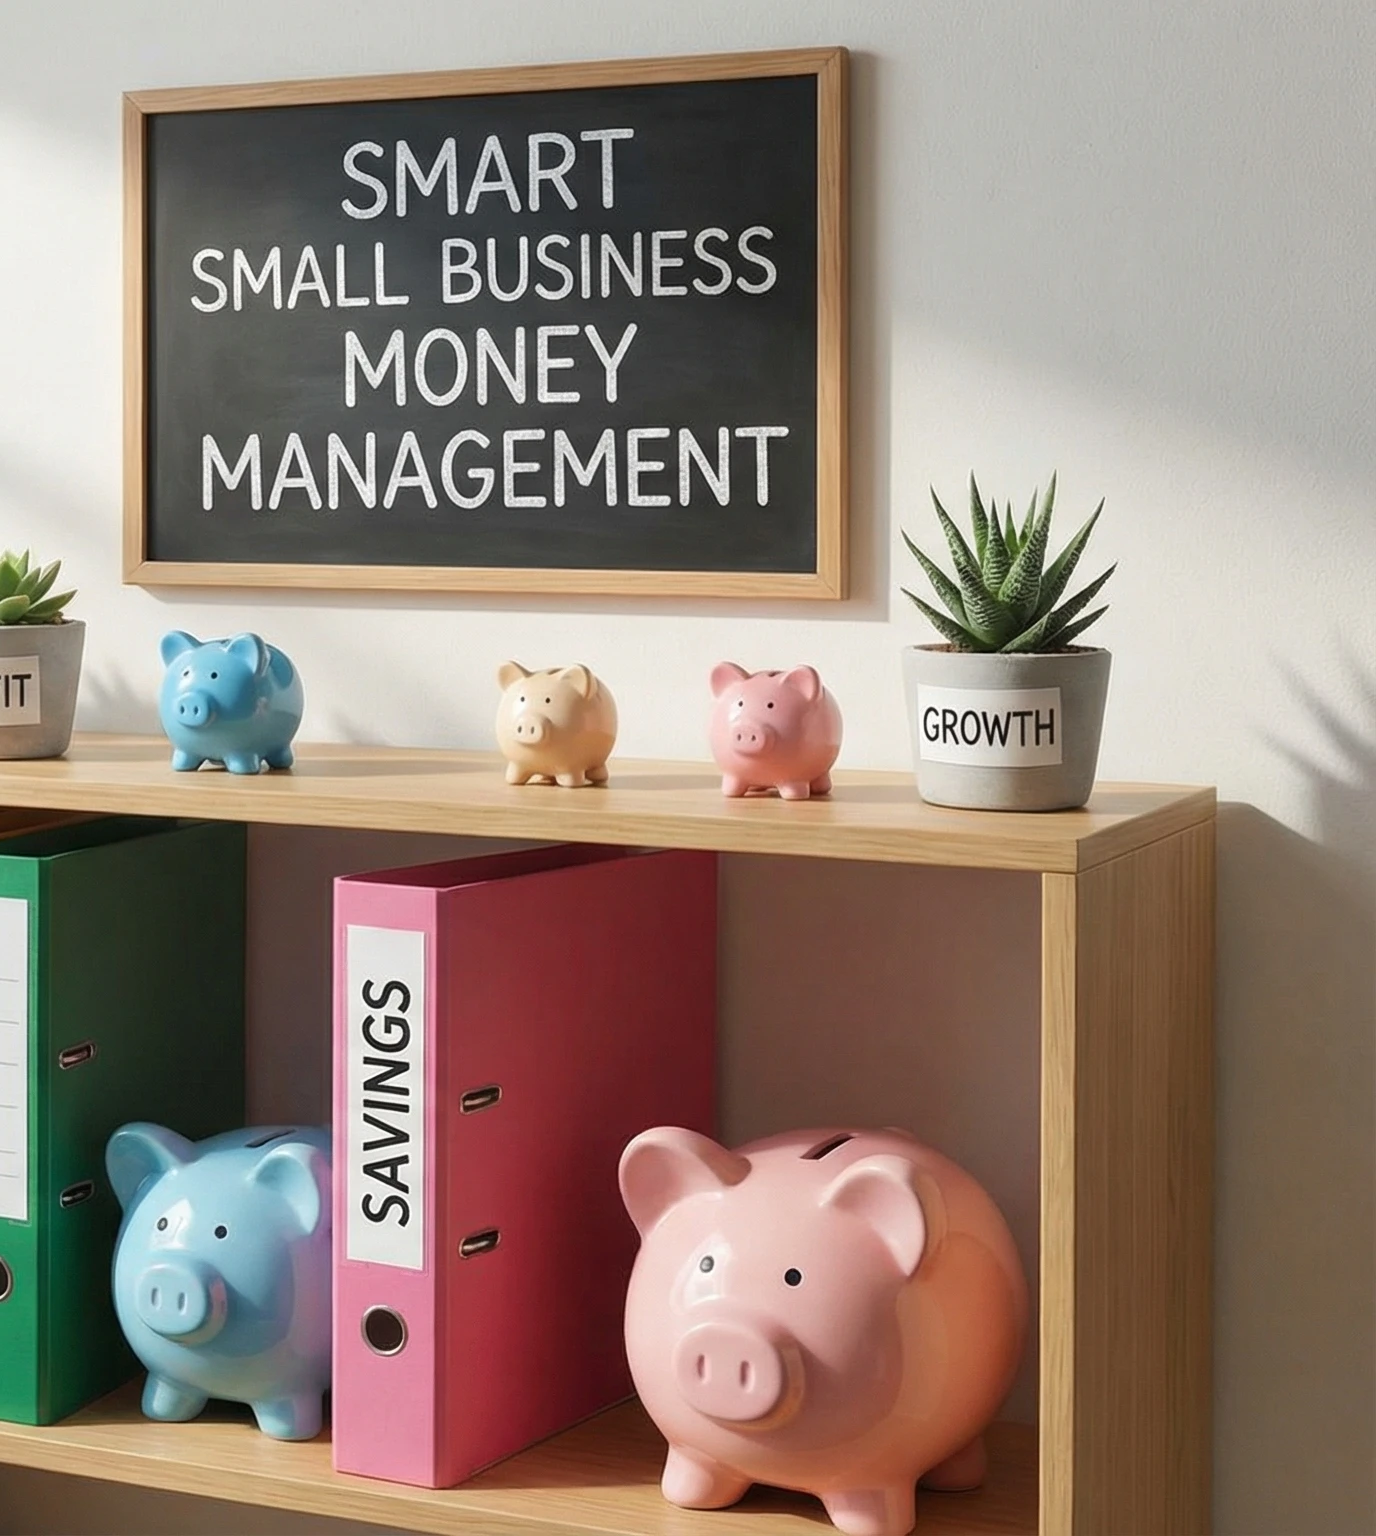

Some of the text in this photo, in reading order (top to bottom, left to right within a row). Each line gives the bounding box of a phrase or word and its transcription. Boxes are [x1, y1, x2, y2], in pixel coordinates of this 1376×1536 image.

[341, 128, 635, 220] SMART
[190, 226, 777, 313] SMALL BUSINESS
[344, 322, 638, 408] MONEY
[202, 426, 790, 511] MANAGEMENT
[922, 706, 1055, 748] GROWTH
[361, 979, 411, 1228] SAVINGS
